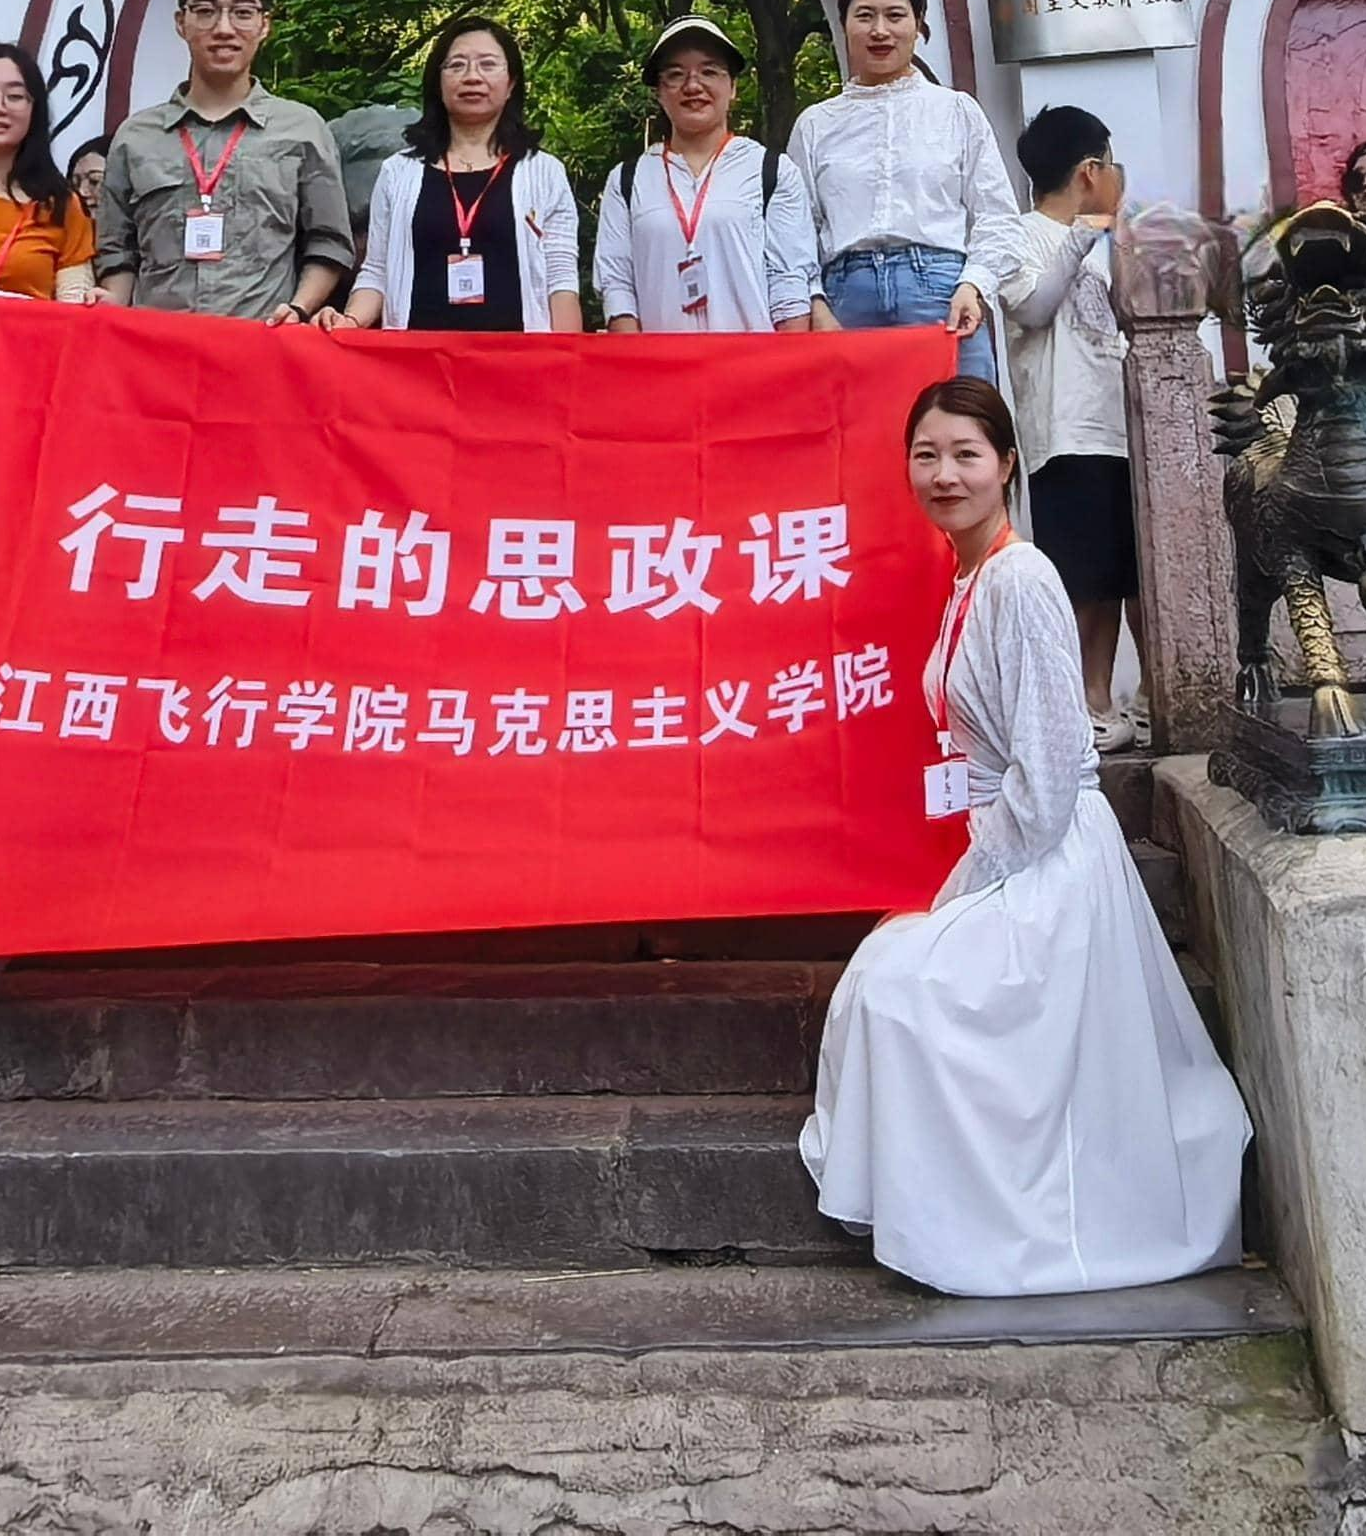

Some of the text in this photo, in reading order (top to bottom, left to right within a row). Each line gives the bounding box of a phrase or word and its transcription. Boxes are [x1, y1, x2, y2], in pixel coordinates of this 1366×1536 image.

[58, 480, 855, 622] 行走的思政课
